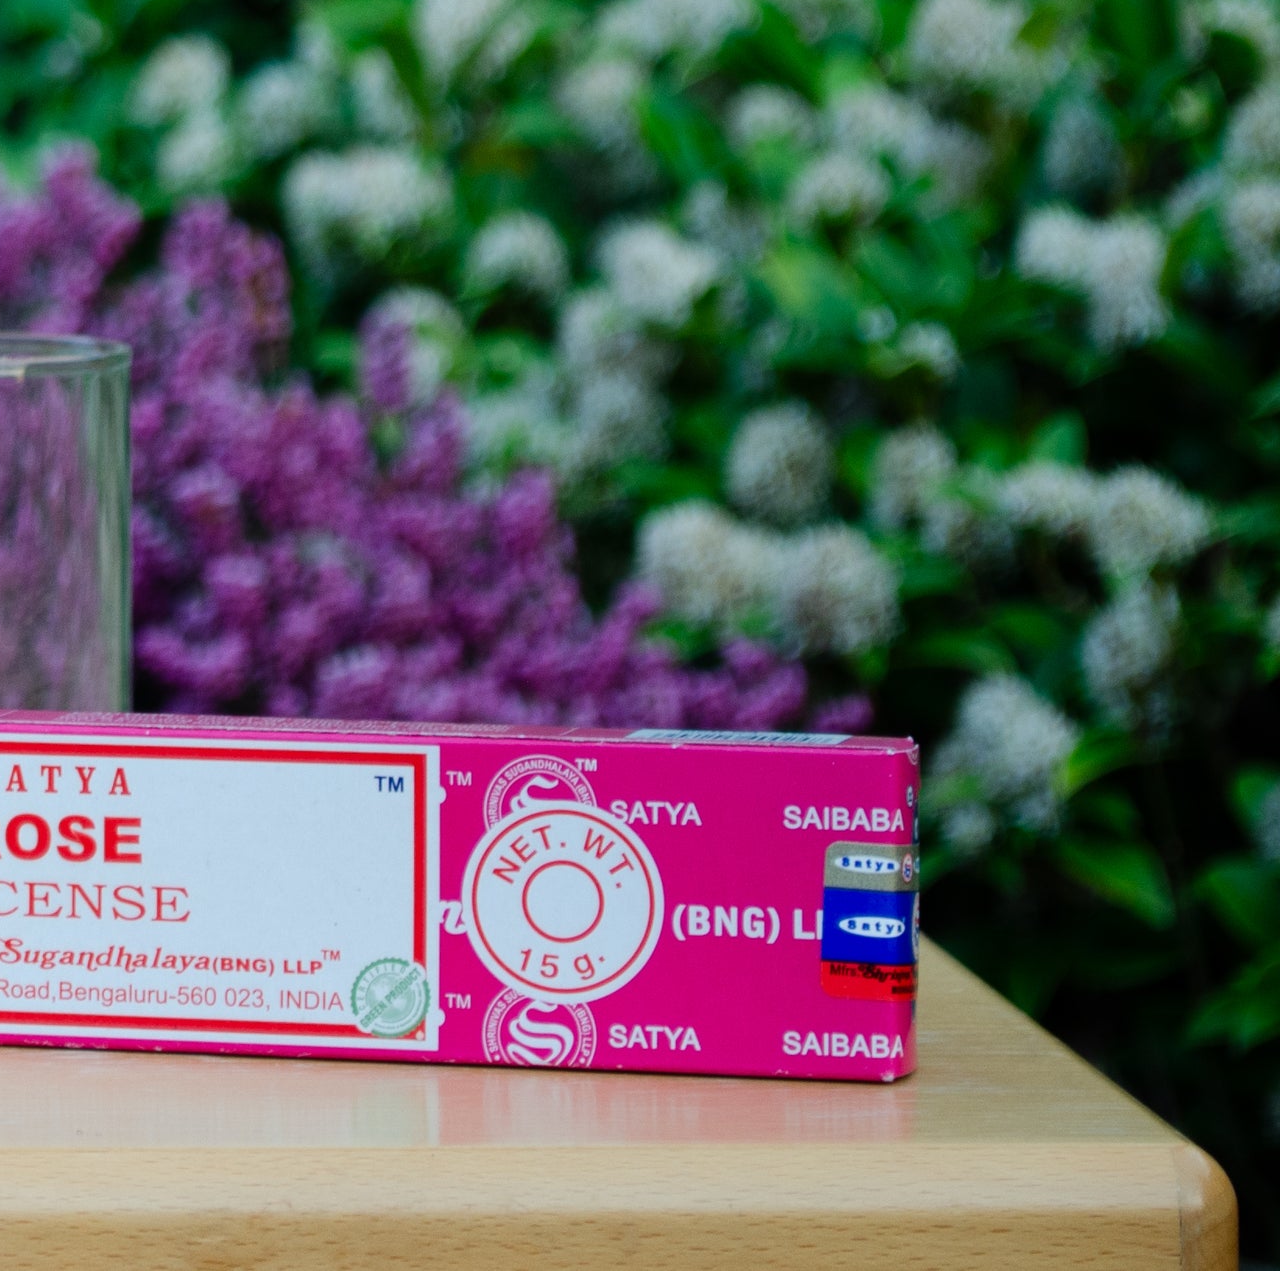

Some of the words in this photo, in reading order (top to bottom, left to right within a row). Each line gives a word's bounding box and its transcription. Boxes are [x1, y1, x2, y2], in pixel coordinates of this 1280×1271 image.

[504, 759, 579, 784] SUGANDHALAYA
[576, 758, 597, 772] TM
[375, 776, 405, 793] TM
[446, 771, 472, 786] TM
[609, 799, 703, 827] SATYA
[783, 805, 906, 833] SAIBABA
[492, 825, 567, 885] NET.
[841, 856, 895, 871] Satya
[671, 904, 781, 944] (BNG)
[224, 988, 271, 1011] 023,
[280, 990, 345, 1011] INDIA
[445, 994, 471, 1009] TM
[608, 1023, 702, 1051] SATYA
[782, 1030, 905, 1058] SAIBABA
